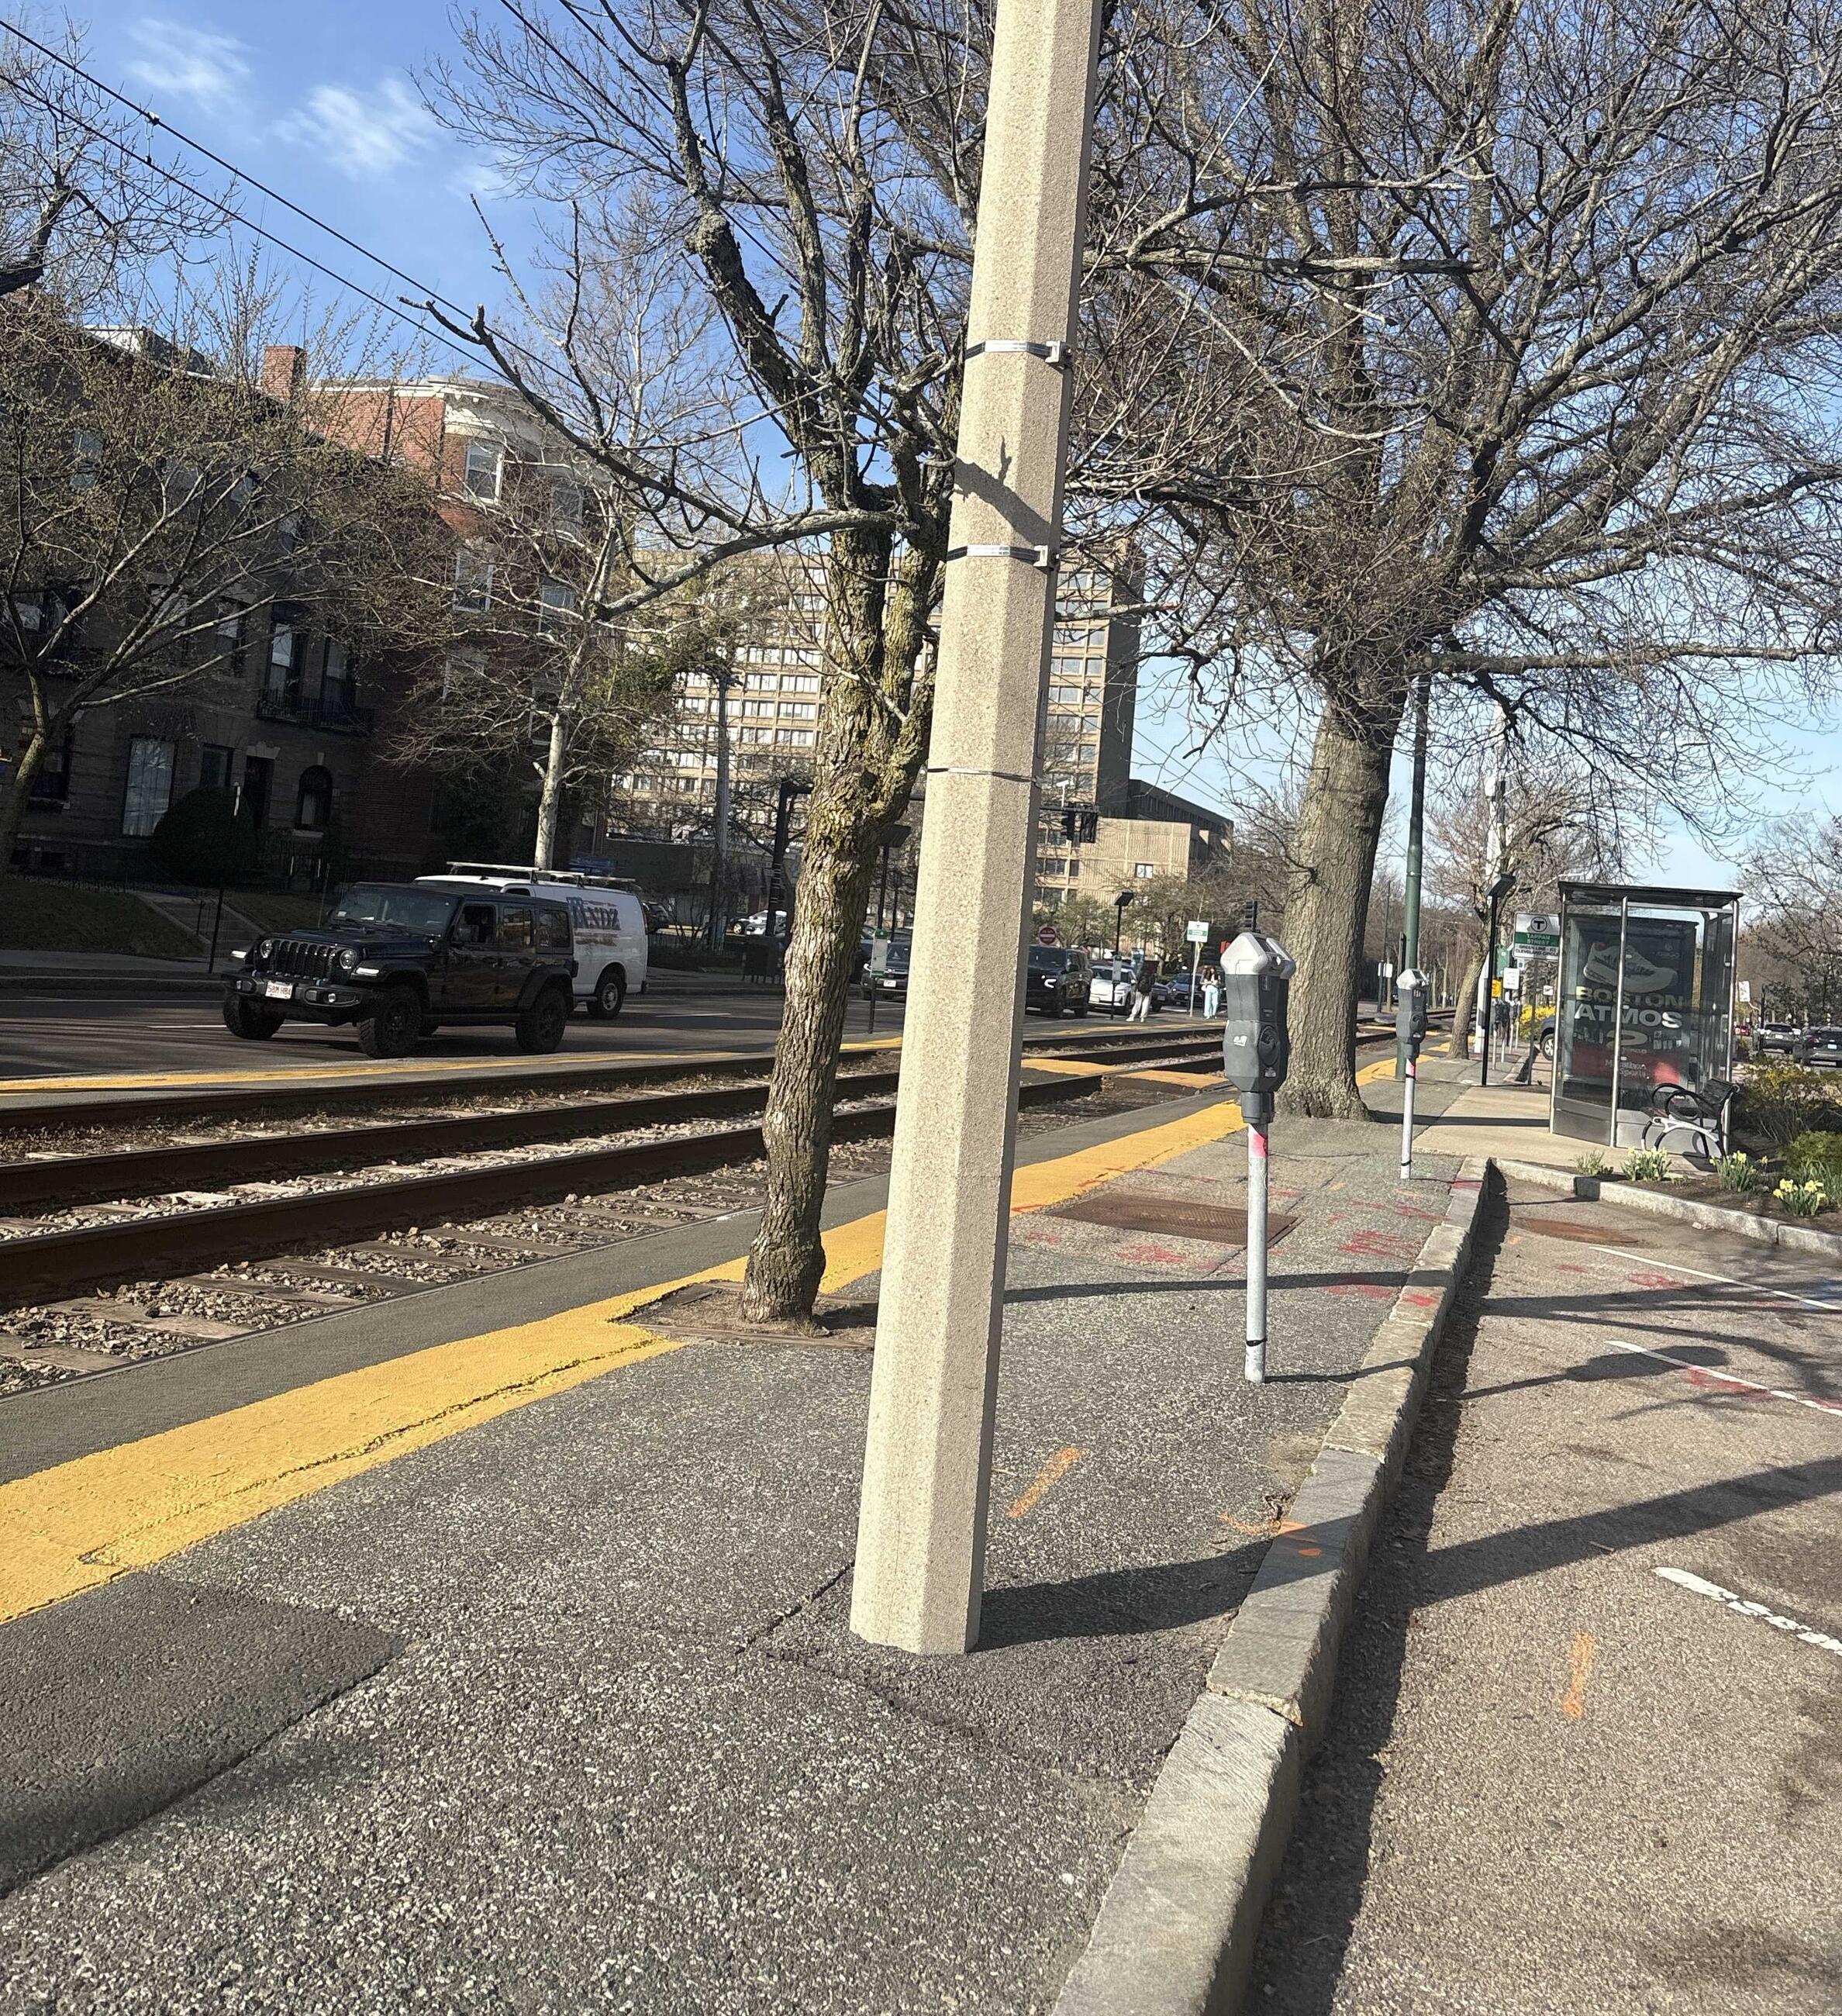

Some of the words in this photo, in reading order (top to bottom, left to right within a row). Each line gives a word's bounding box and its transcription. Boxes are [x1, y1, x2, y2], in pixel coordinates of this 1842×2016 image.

[1533, 920, 1545, 930] T
[1576, 986, 1684, 1008] BOSTON
[1575, 1003, 1682, 1028] ATMOS
[1605, 1058, 1647, 1070] Mathon
